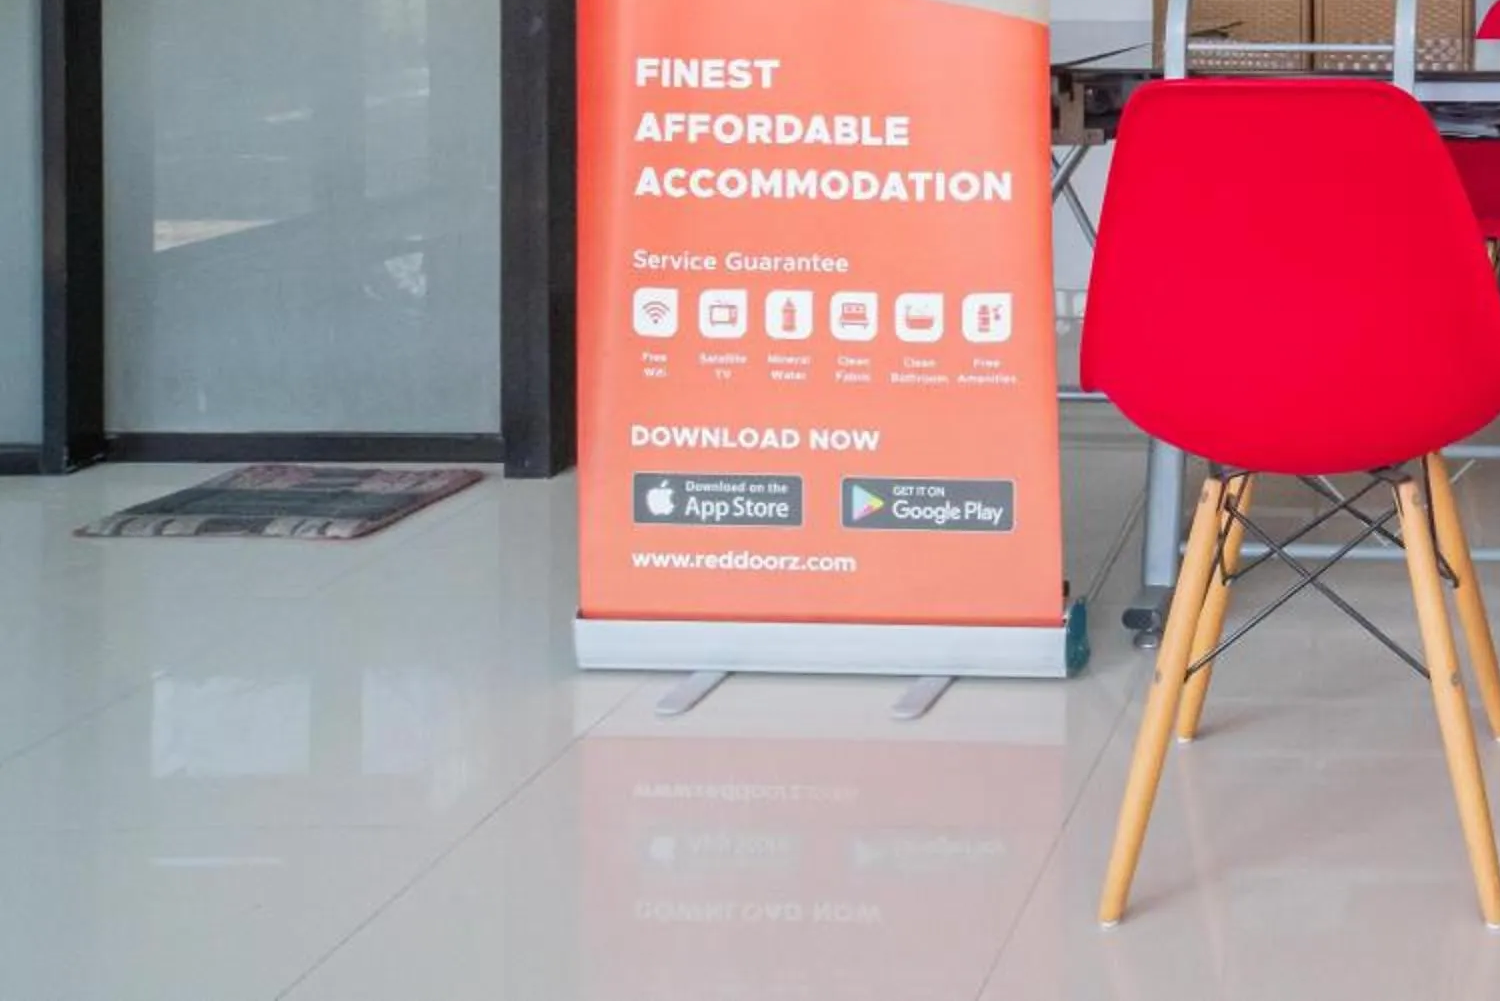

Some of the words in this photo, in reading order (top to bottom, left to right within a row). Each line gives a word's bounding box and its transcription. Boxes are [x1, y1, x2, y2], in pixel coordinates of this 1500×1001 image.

[635, 57, 781, 89] FINEST
[634, 112, 910, 147] AFFORDABLE
[634, 166, 1012, 202] ACCOMMODATION
[632, 249, 717, 272] Service
[724, 251, 850, 274] Guarantee
[630, 424, 801, 450] DOWNLOAD
[809, 427, 881, 452] NOW
[684, 479, 746, 495] Download
[748, 482, 764, 495] on
[767, 481, 790, 496] the
[892, 485, 914, 498] GET
[915, 485, 927, 498] IT
[928, 485, 946, 498] ON
[684, 496, 730, 522] App
[732, 496, 790, 520] Store
[892, 500, 961, 525] Google
[965, 501, 1003, 526] Play
[631, 550, 858, 573] www.reddoorz.com
